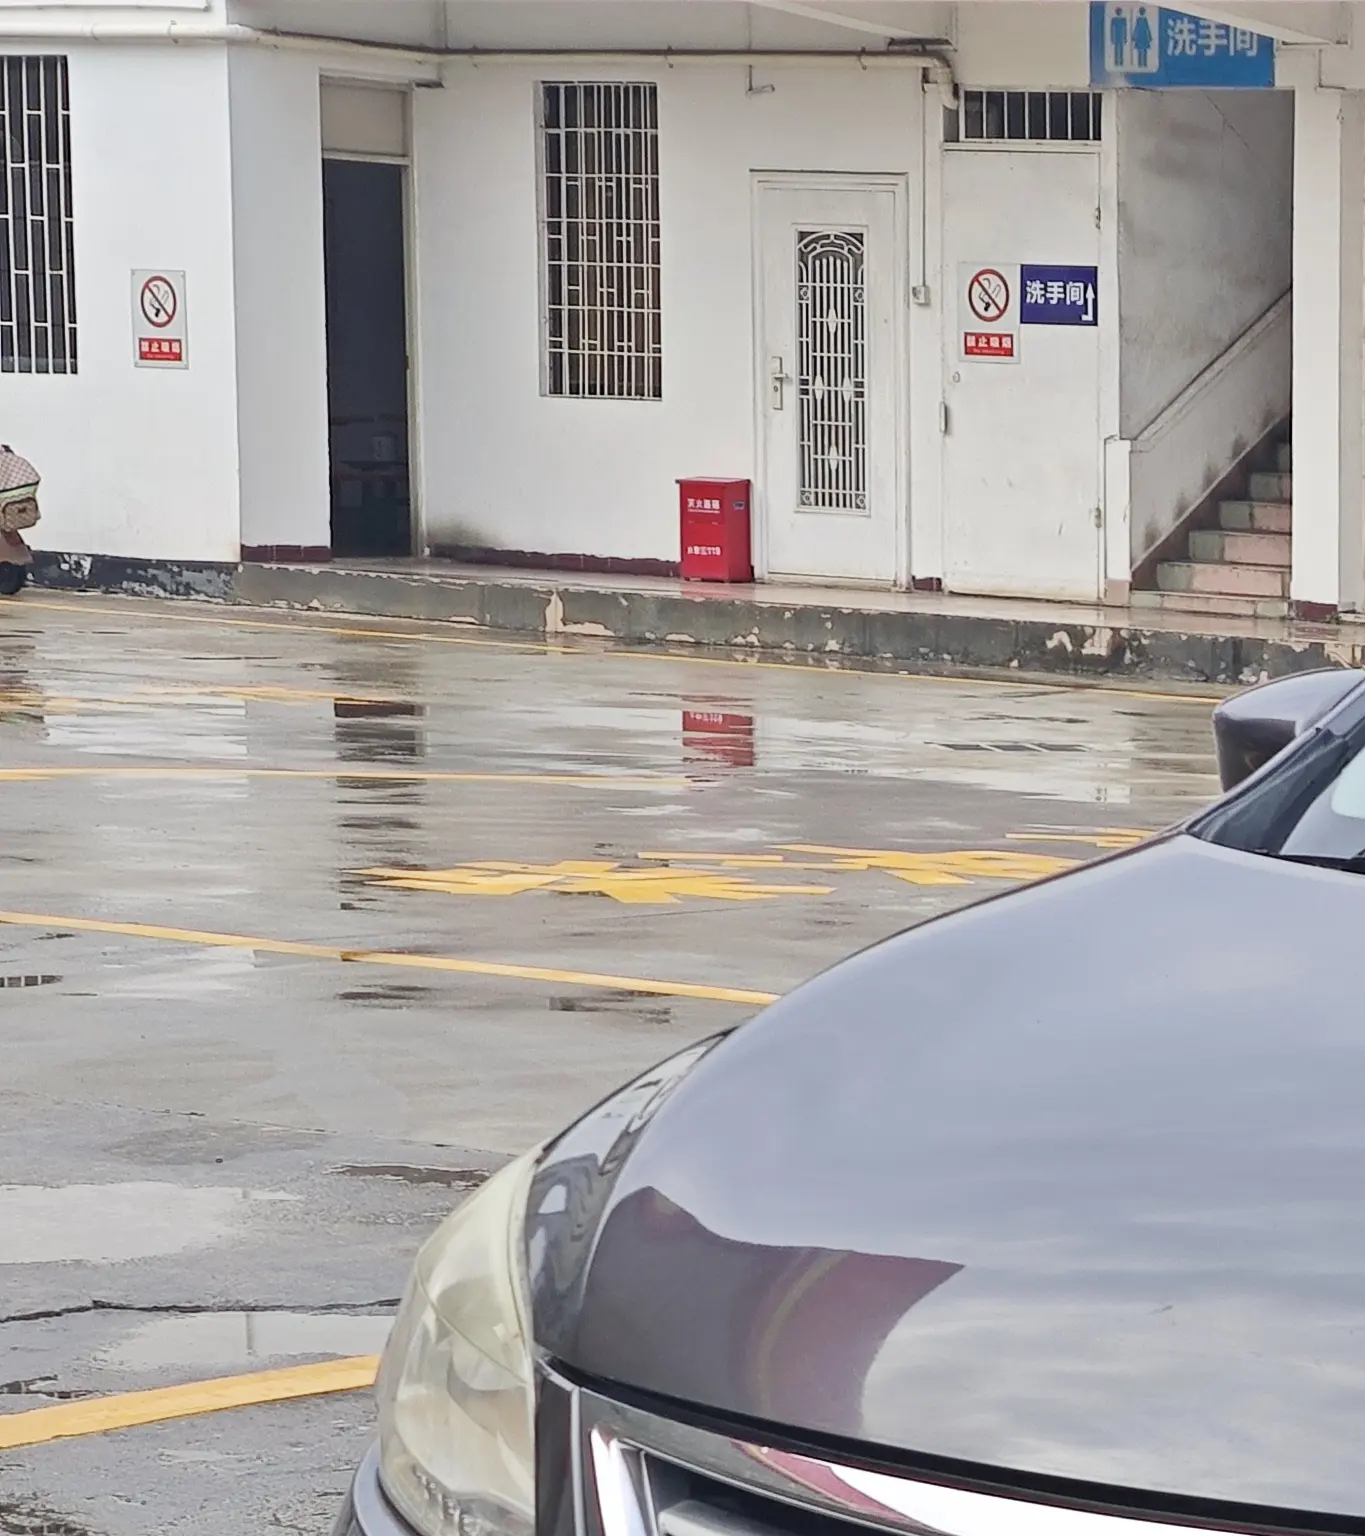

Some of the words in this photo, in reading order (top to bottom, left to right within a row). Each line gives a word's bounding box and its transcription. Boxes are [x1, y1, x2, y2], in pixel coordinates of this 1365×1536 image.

[1166, 17, 1259, 57] 洗手间
[1025, 279, 1085, 306] 洗手间
